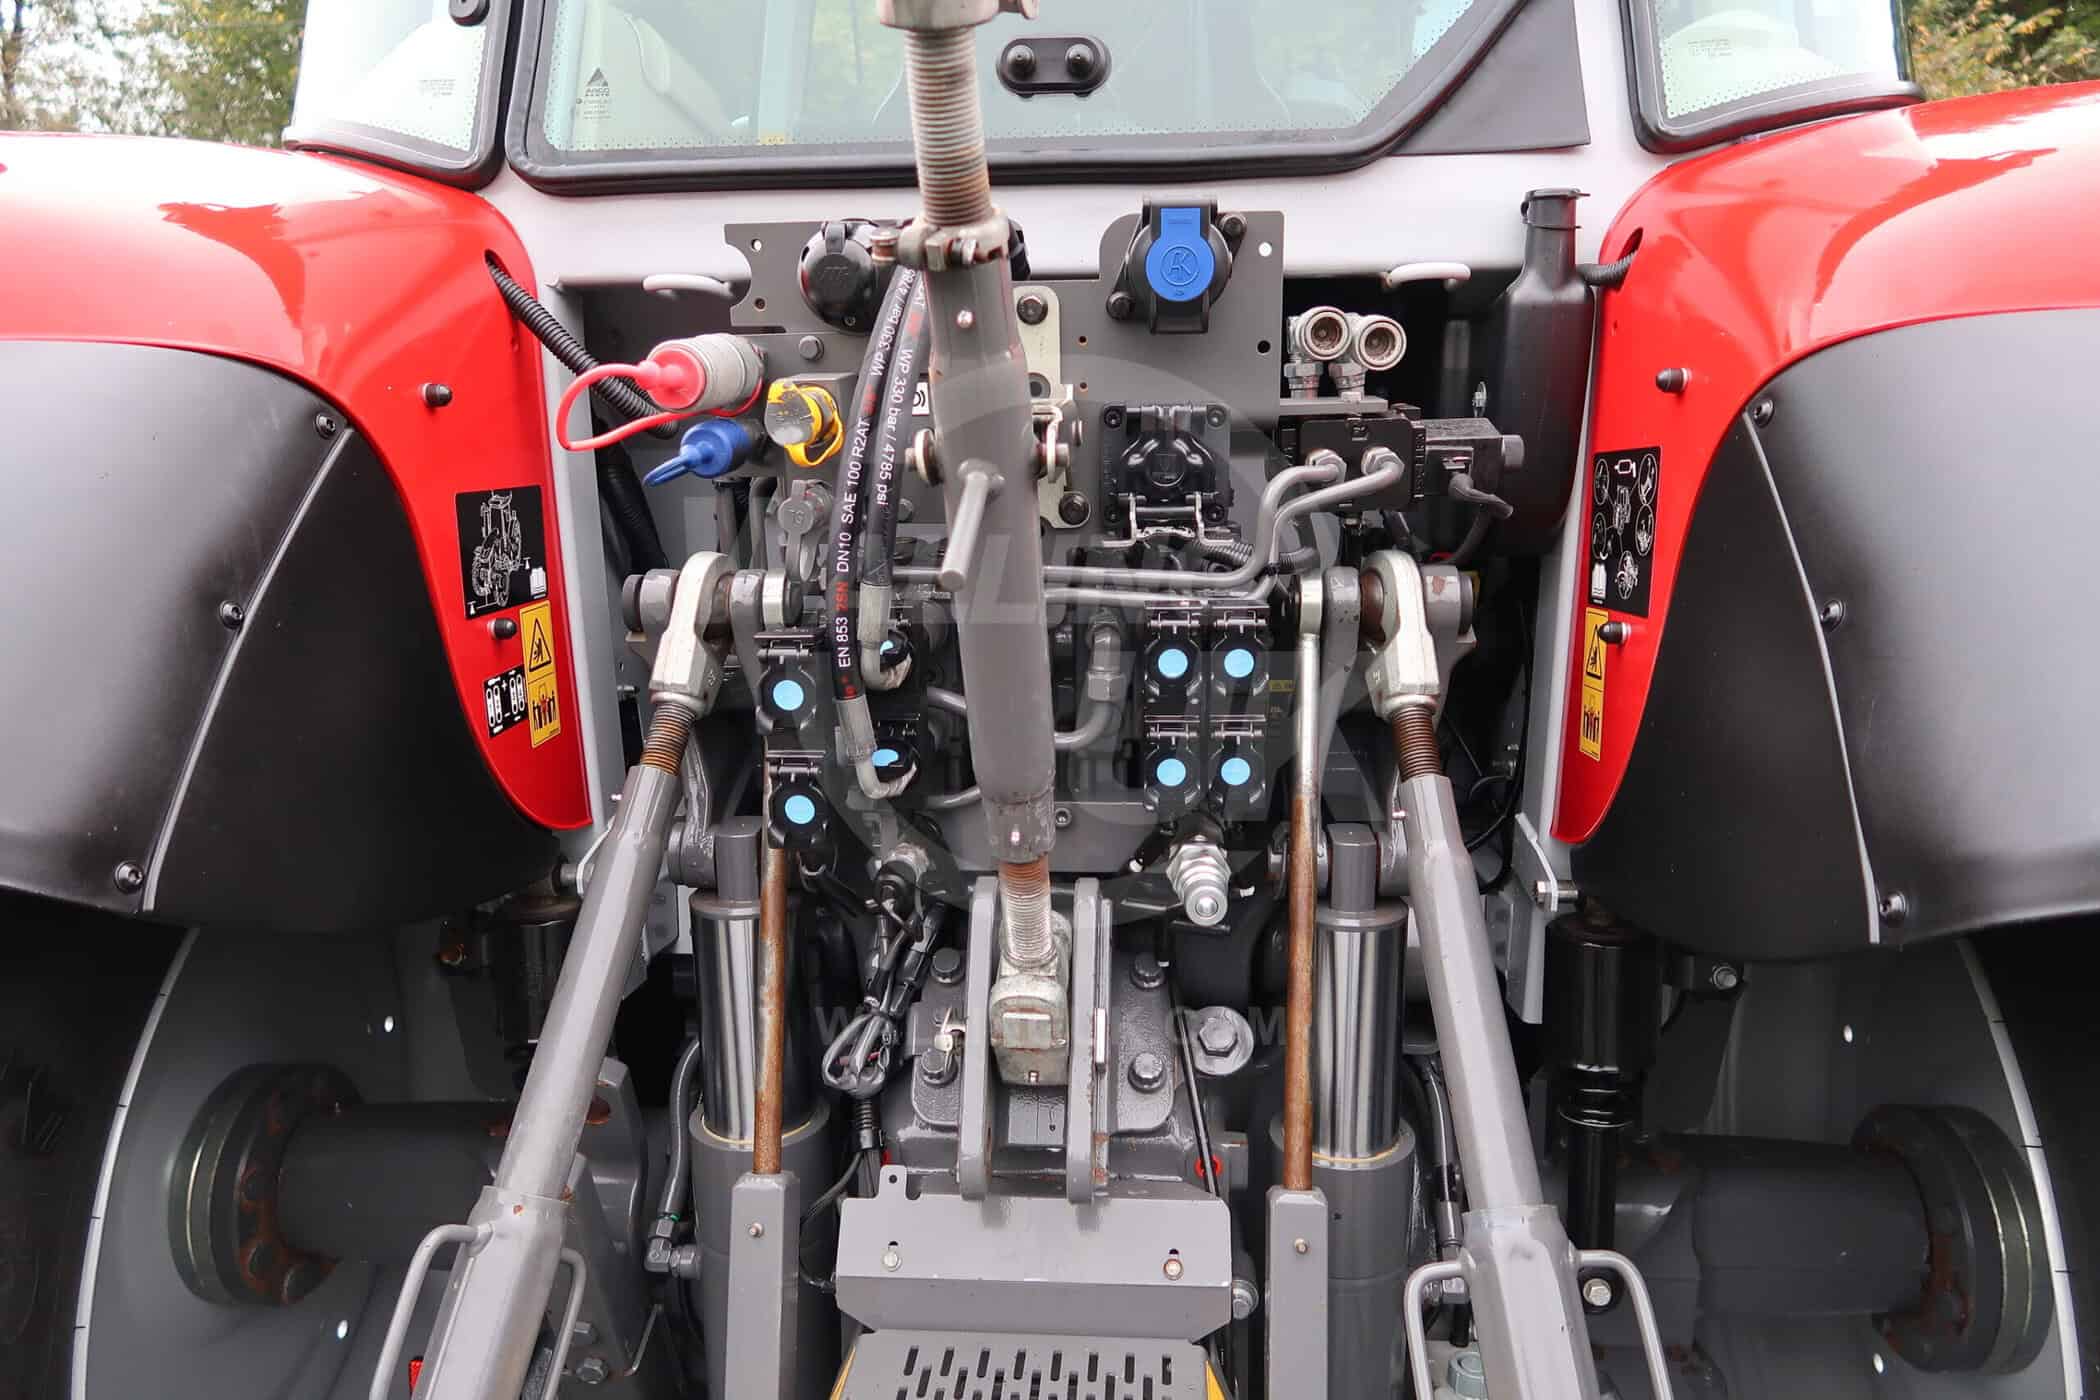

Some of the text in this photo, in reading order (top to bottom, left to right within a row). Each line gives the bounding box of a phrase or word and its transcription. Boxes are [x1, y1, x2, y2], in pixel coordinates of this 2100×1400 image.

[888, 304, 904, 325] bar
[877, 326, 896, 351] 330
[869, 351, 887, 376] WP
[900, 348, 914, 373] WP
[890, 376, 907, 404] 330
[887, 406, 902, 431] bar
[851, 416, 871, 458] R2AT
[847, 460, 863, 487] 100
[879, 443, 895, 481] 4785
[876, 482, 889, 507] psi
[841, 491, 858, 525] SAE
[836, 532, 852, 573] DN10
[835, 616, 849, 643] 853
[838, 647, 851, 668] EN
